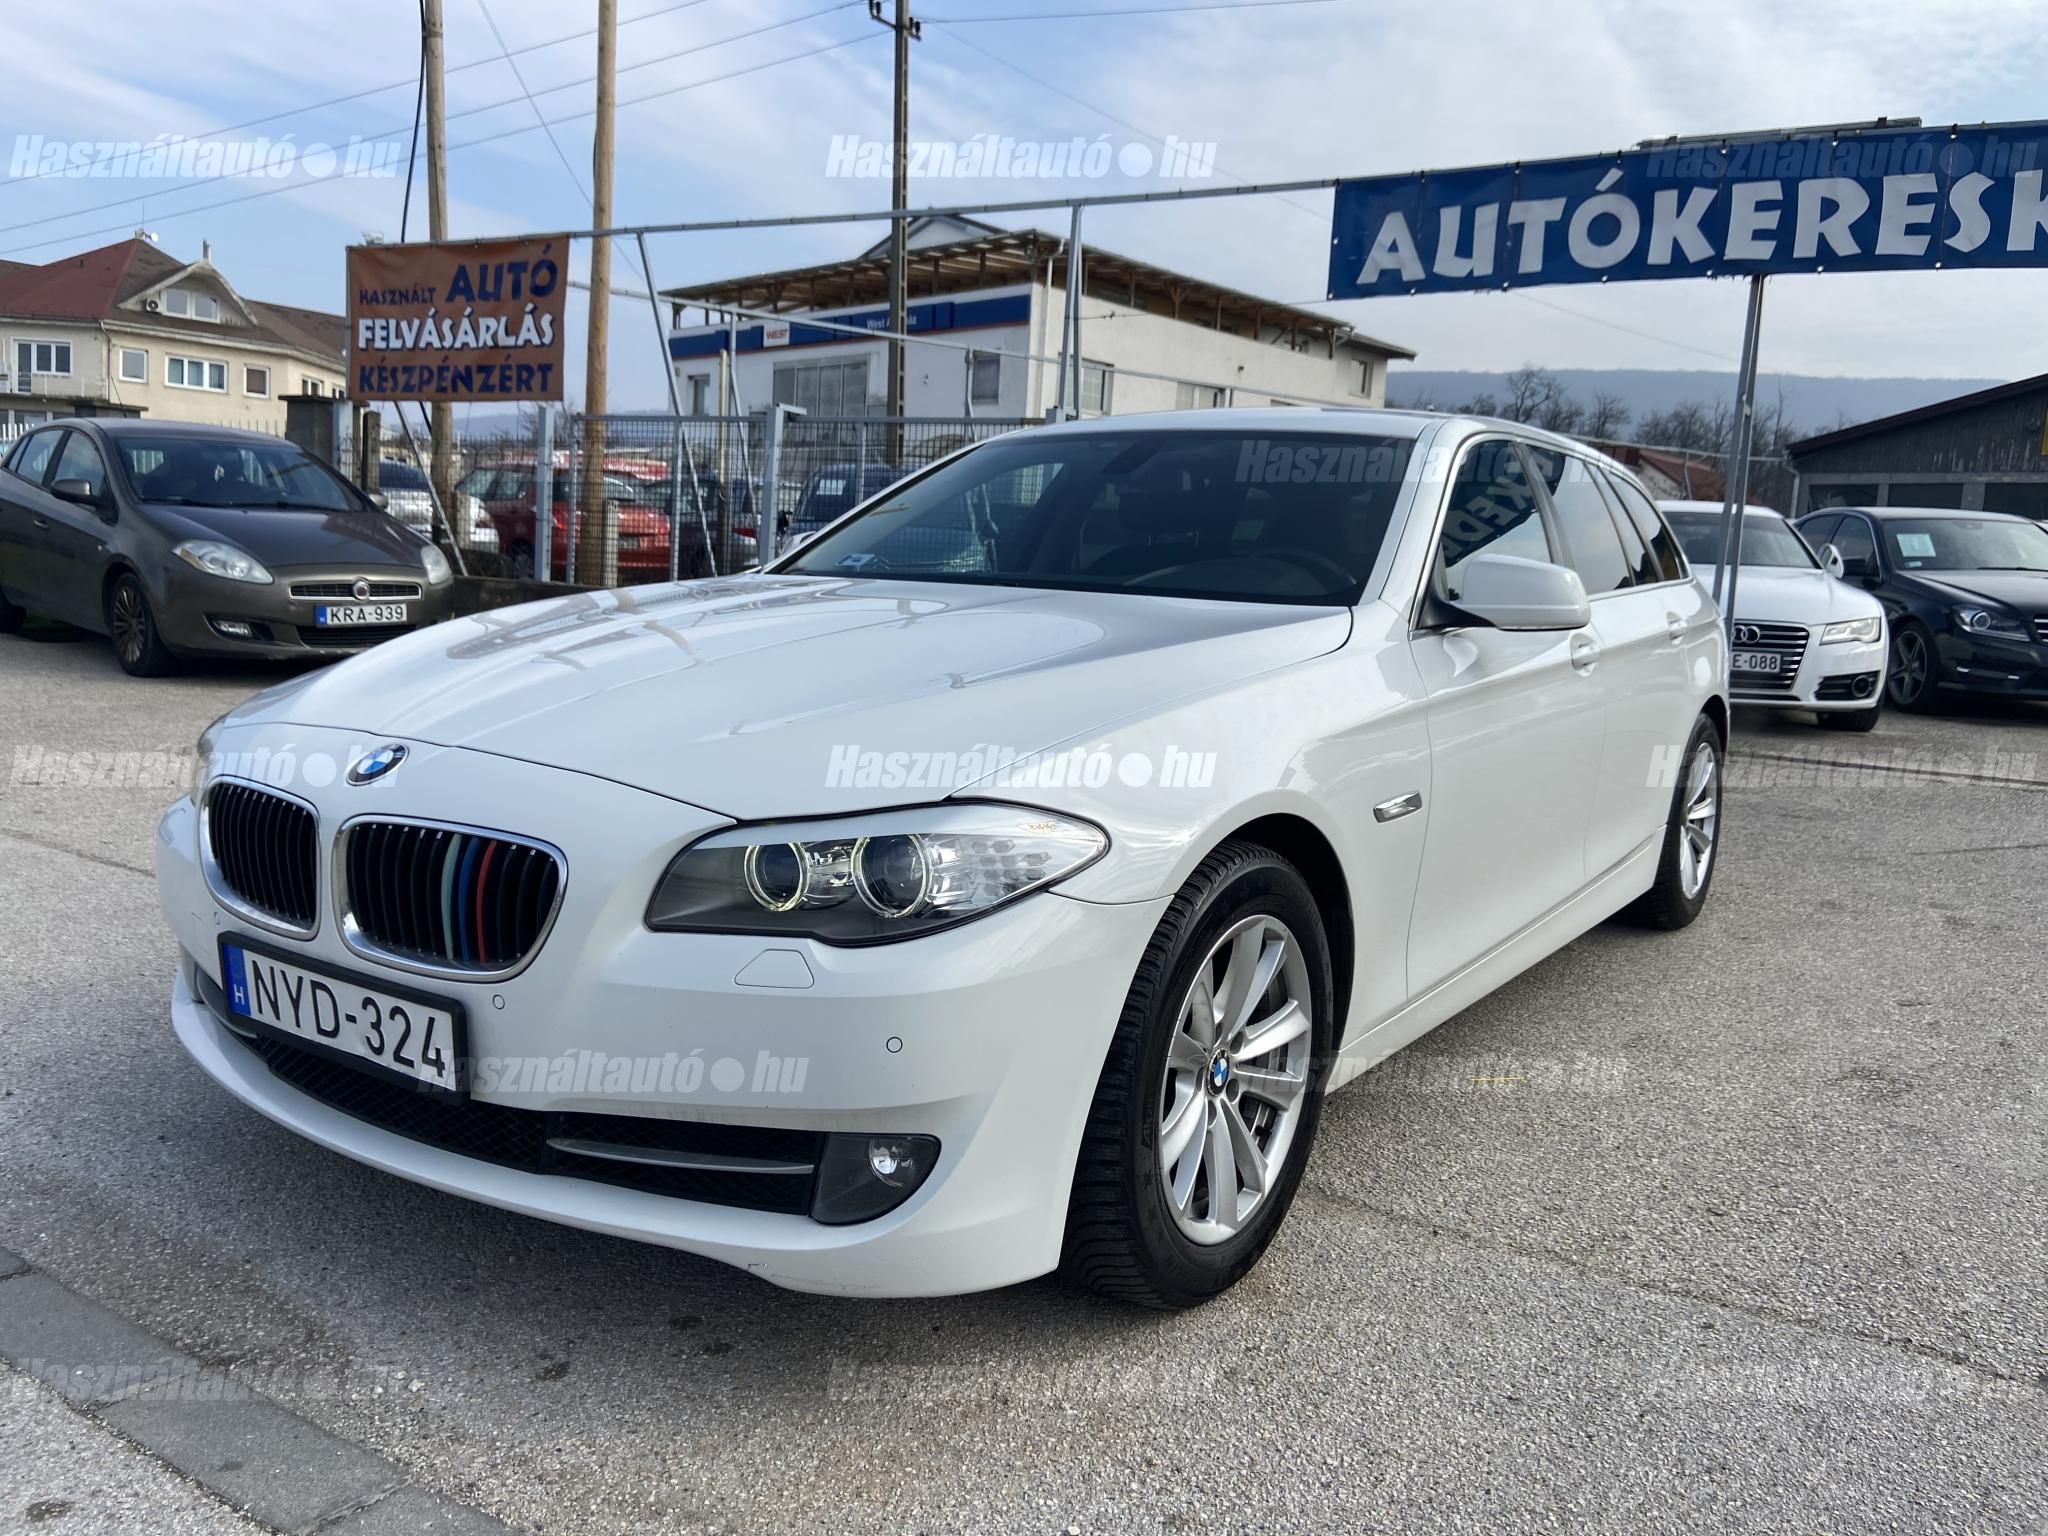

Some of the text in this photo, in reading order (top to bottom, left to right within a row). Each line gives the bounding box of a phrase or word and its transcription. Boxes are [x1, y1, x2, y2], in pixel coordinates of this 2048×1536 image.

[360, 244, 558, 305] HASZNÁLT AUTÓ
[359, 303, 554, 350] FELVÁSÁRLÁS
[360, 354, 553, 393] KÉSZPÉNZÉRT
[330, 606, 403, 622] KRA-939
[252, 960, 446, 1078] NYD-324
